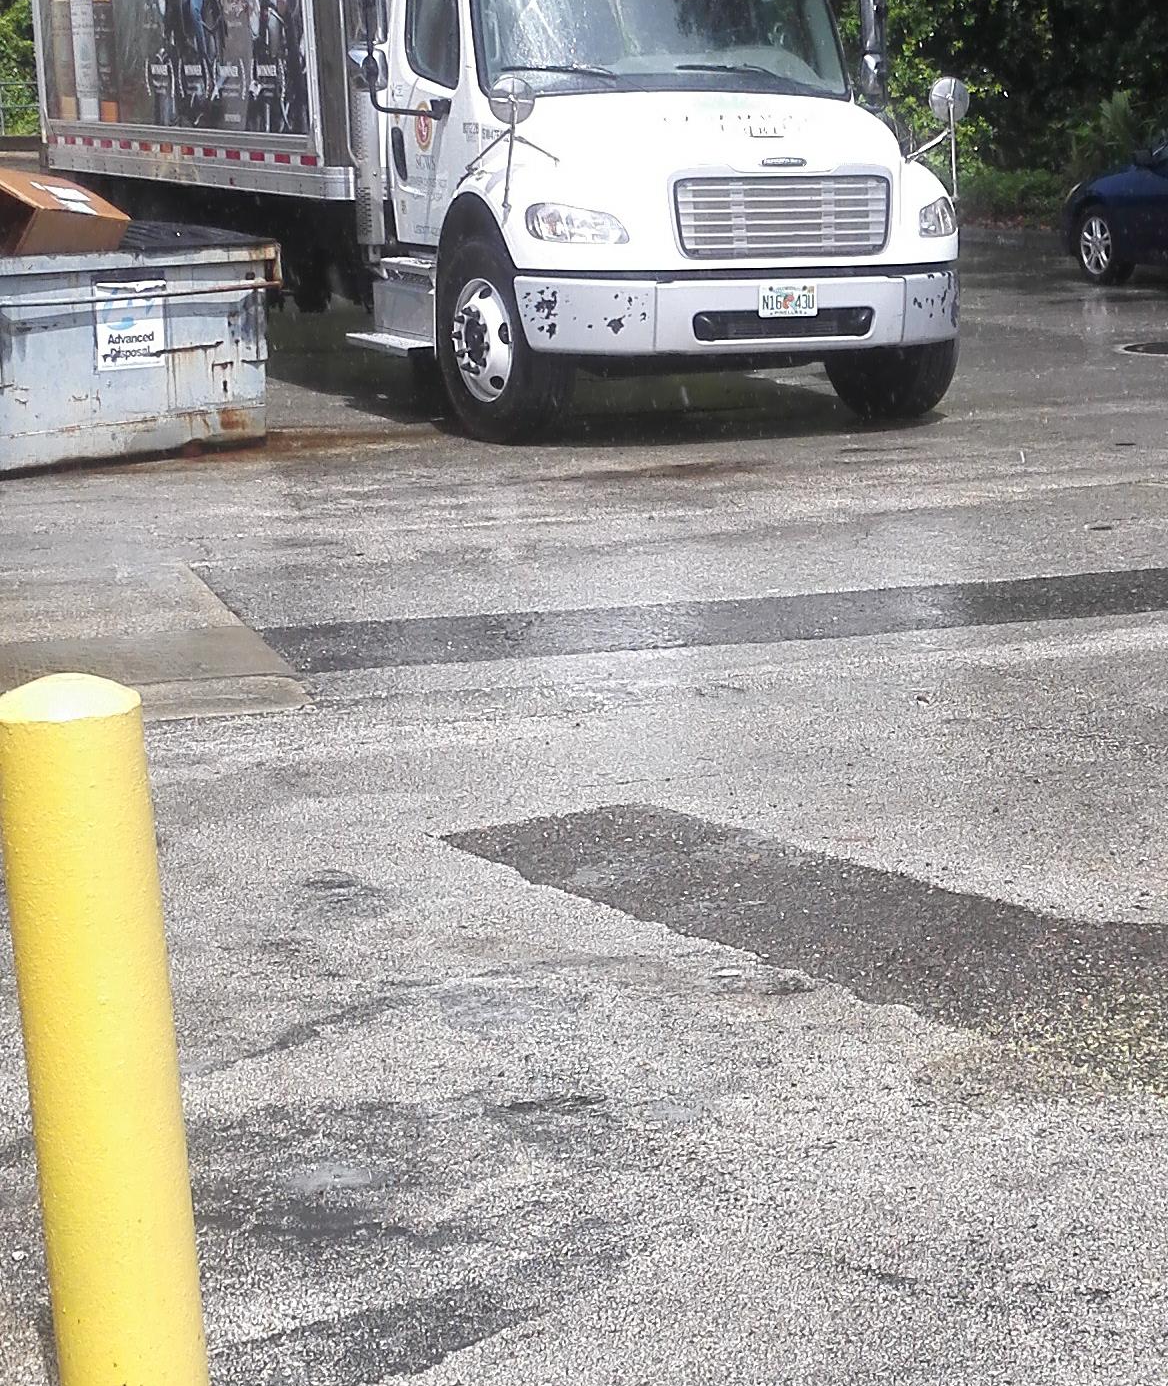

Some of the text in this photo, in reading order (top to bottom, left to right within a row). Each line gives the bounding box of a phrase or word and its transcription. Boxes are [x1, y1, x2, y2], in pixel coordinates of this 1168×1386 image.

[256, 64, 277, 77] WINNER
[107, 331, 155, 345] Advanced
[110, 345, 151, 360] Disposal
